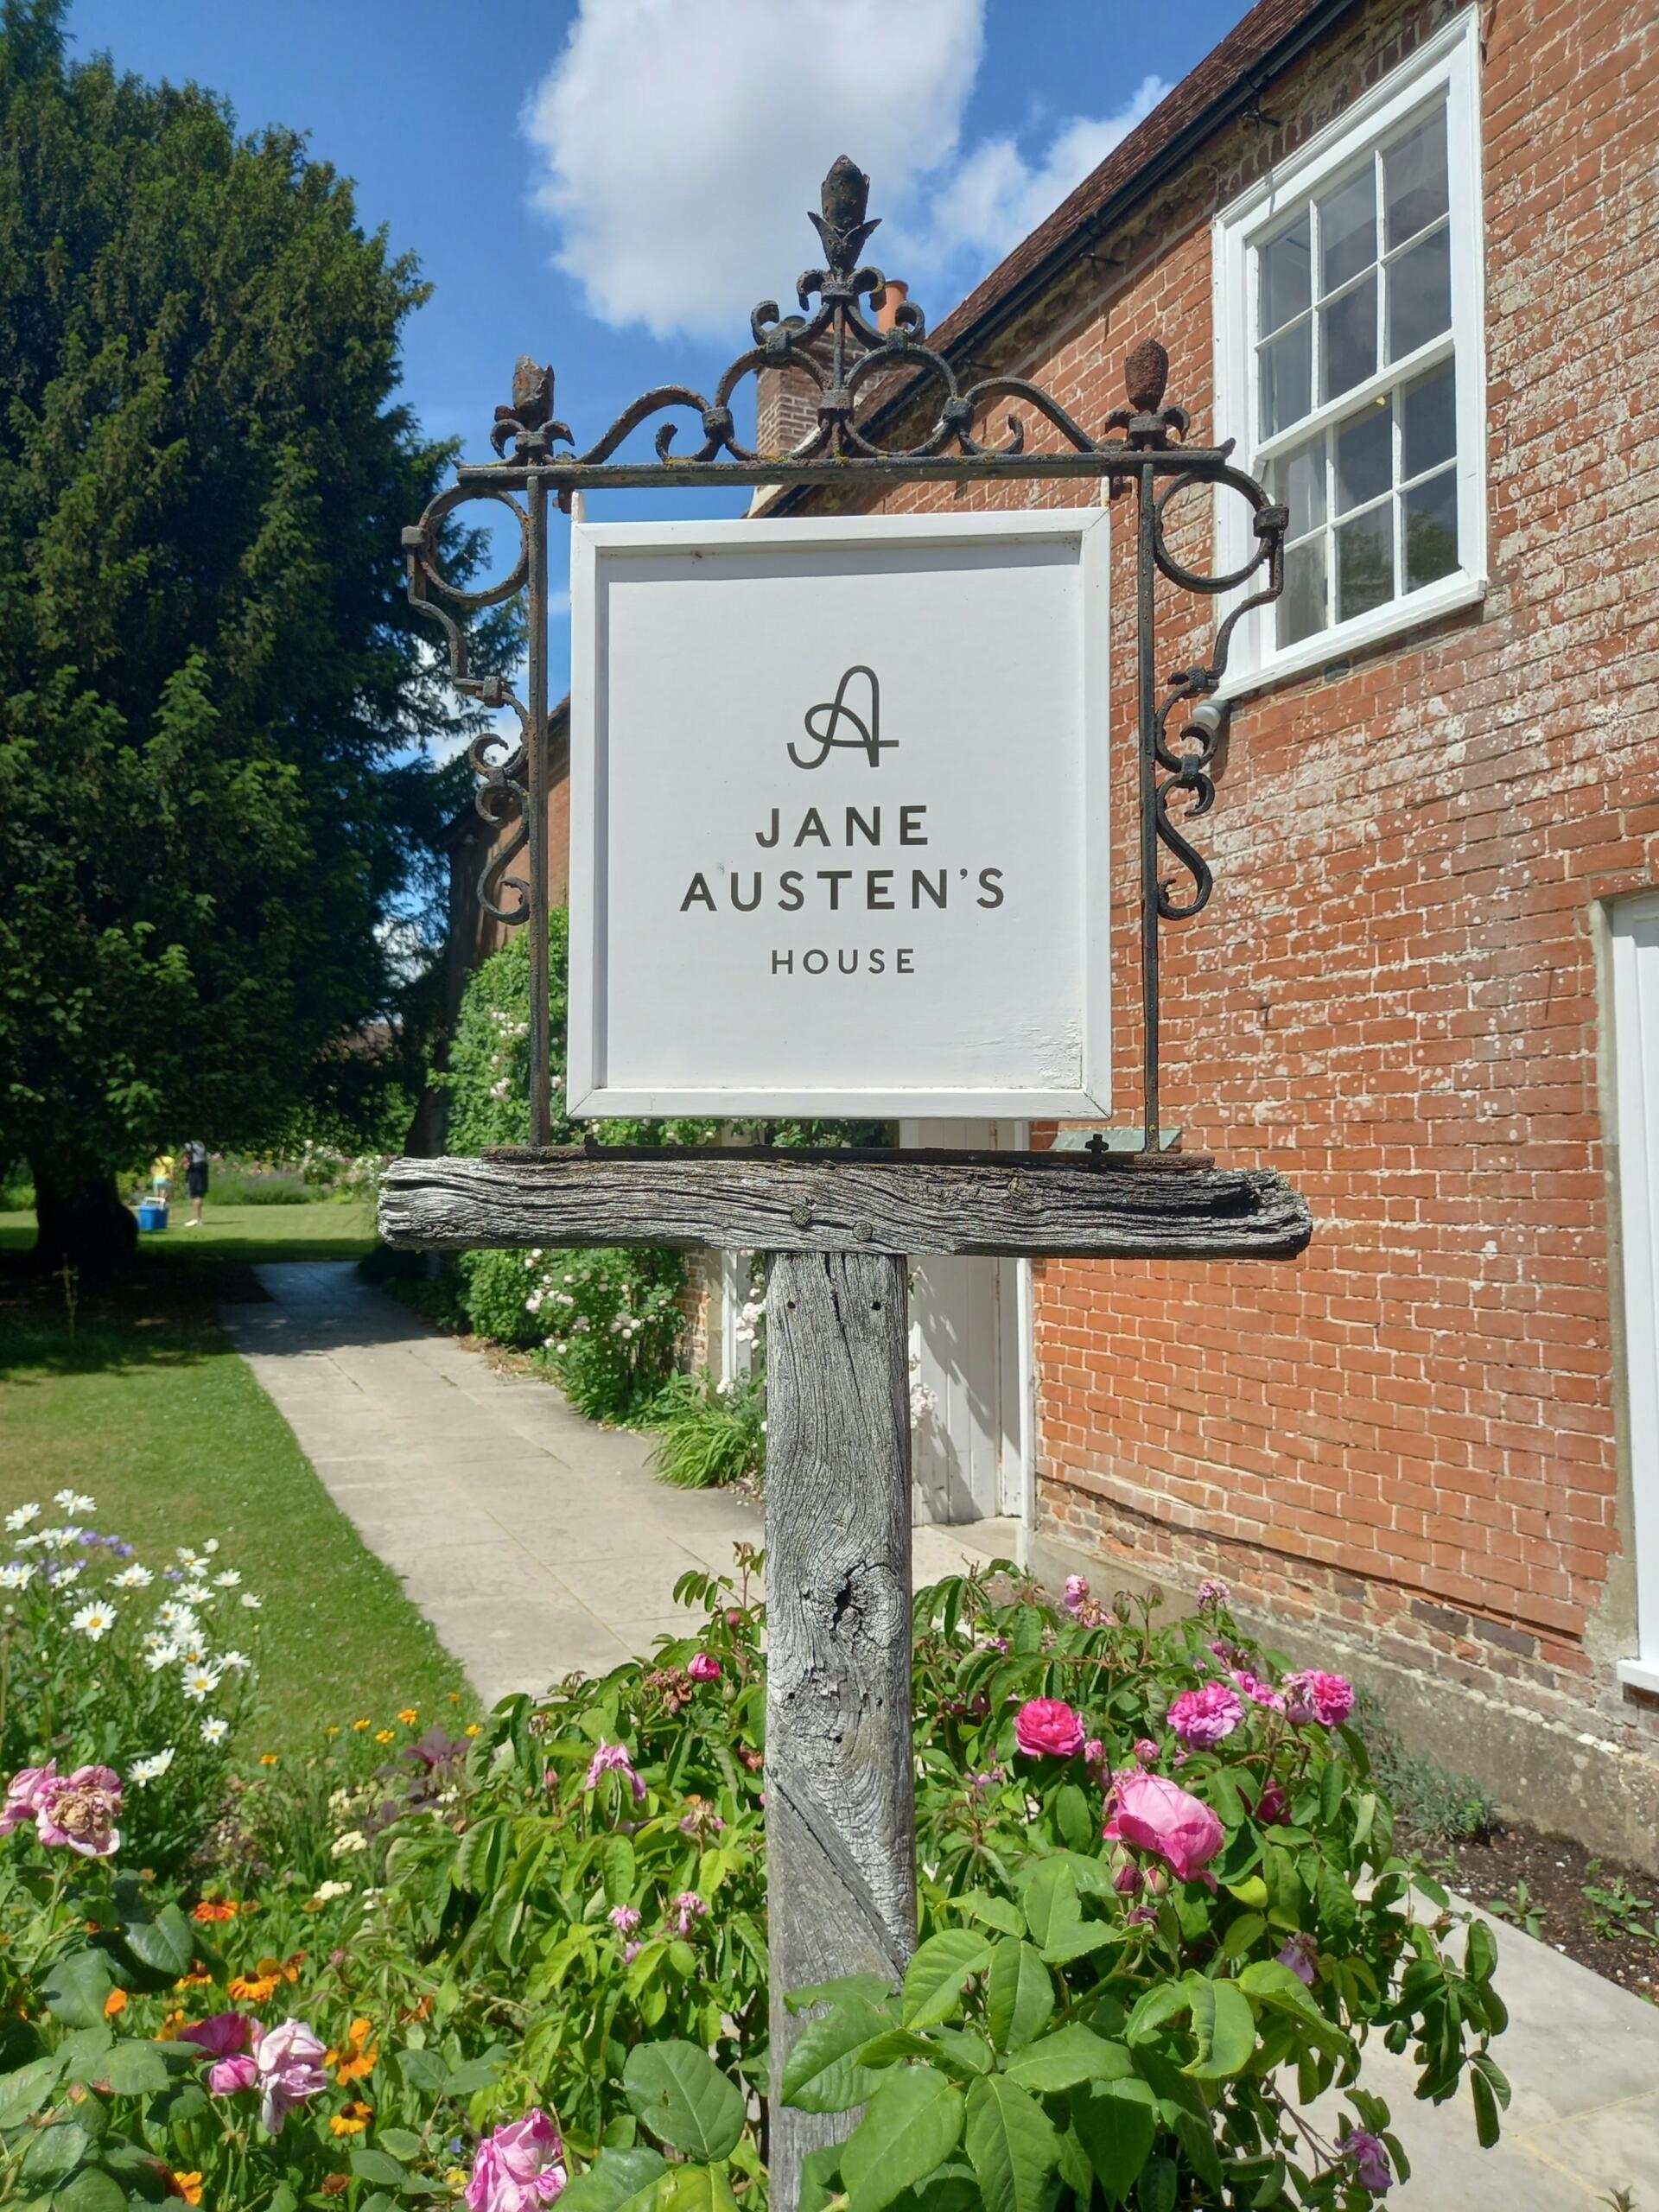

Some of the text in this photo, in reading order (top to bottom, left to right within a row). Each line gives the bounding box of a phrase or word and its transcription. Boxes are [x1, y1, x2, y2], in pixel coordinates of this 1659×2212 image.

[754, 804, 929, 849] JANE
[679, 867, 1005, 912] AUSTEN'S
[771, 947, 916, 975] HOUSE
